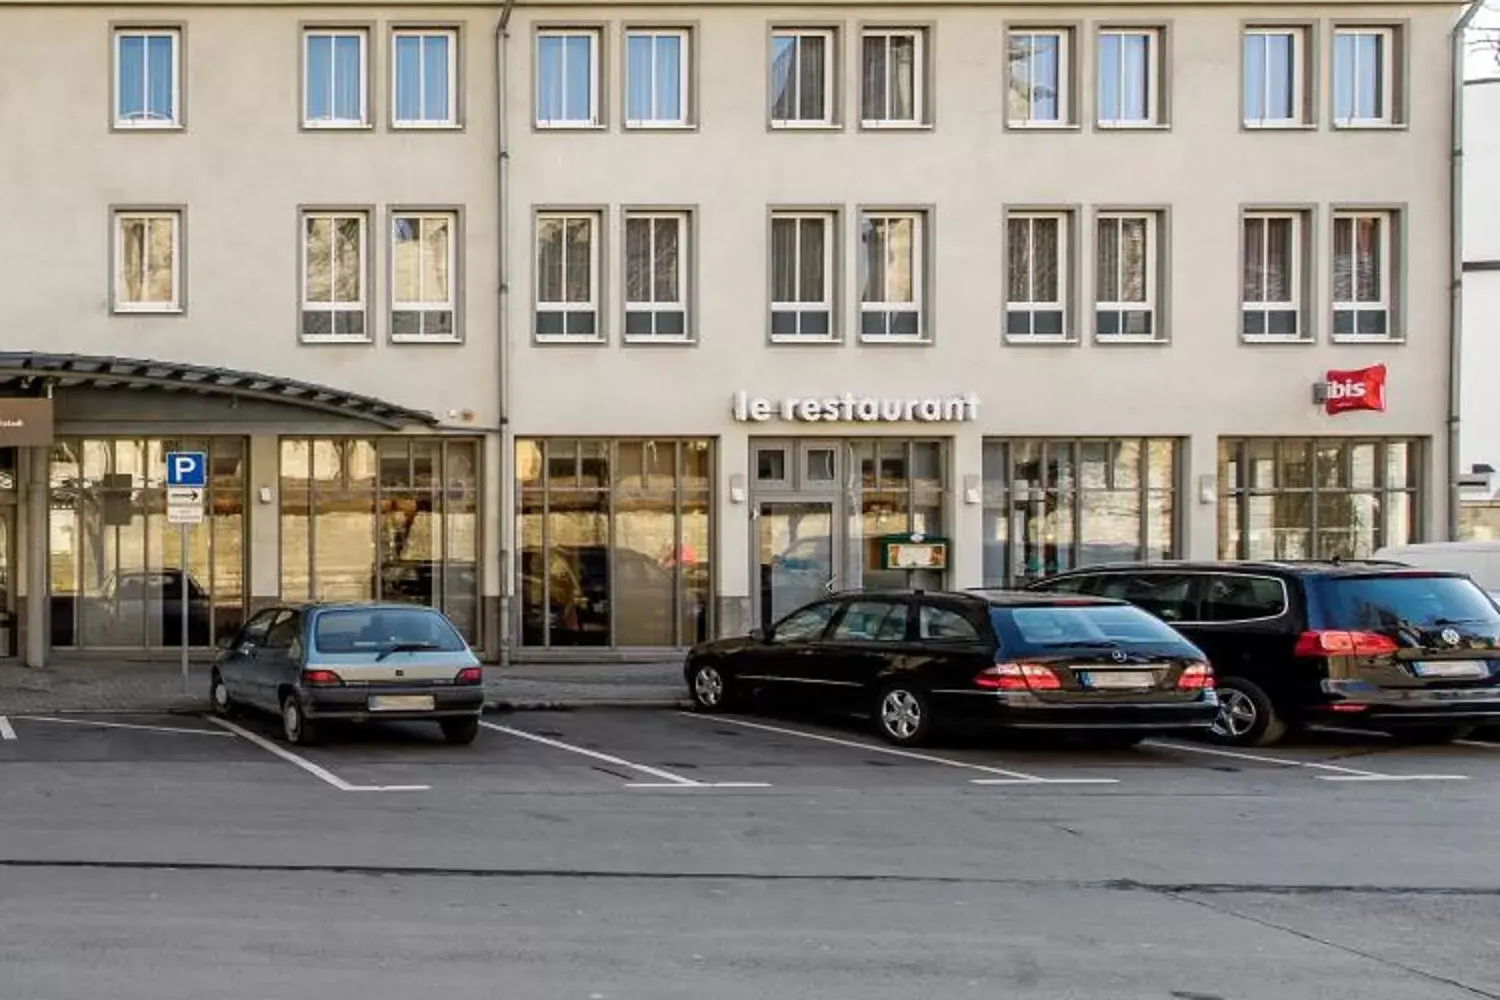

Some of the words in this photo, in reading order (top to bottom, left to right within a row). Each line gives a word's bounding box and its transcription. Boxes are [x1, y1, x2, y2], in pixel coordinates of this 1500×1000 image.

[1327, 379, 1366, 399] ibis
[735, 390, 771, 421] le
[782, 390, 980, 421] restaurant
[175, 457, 196, 482] P
